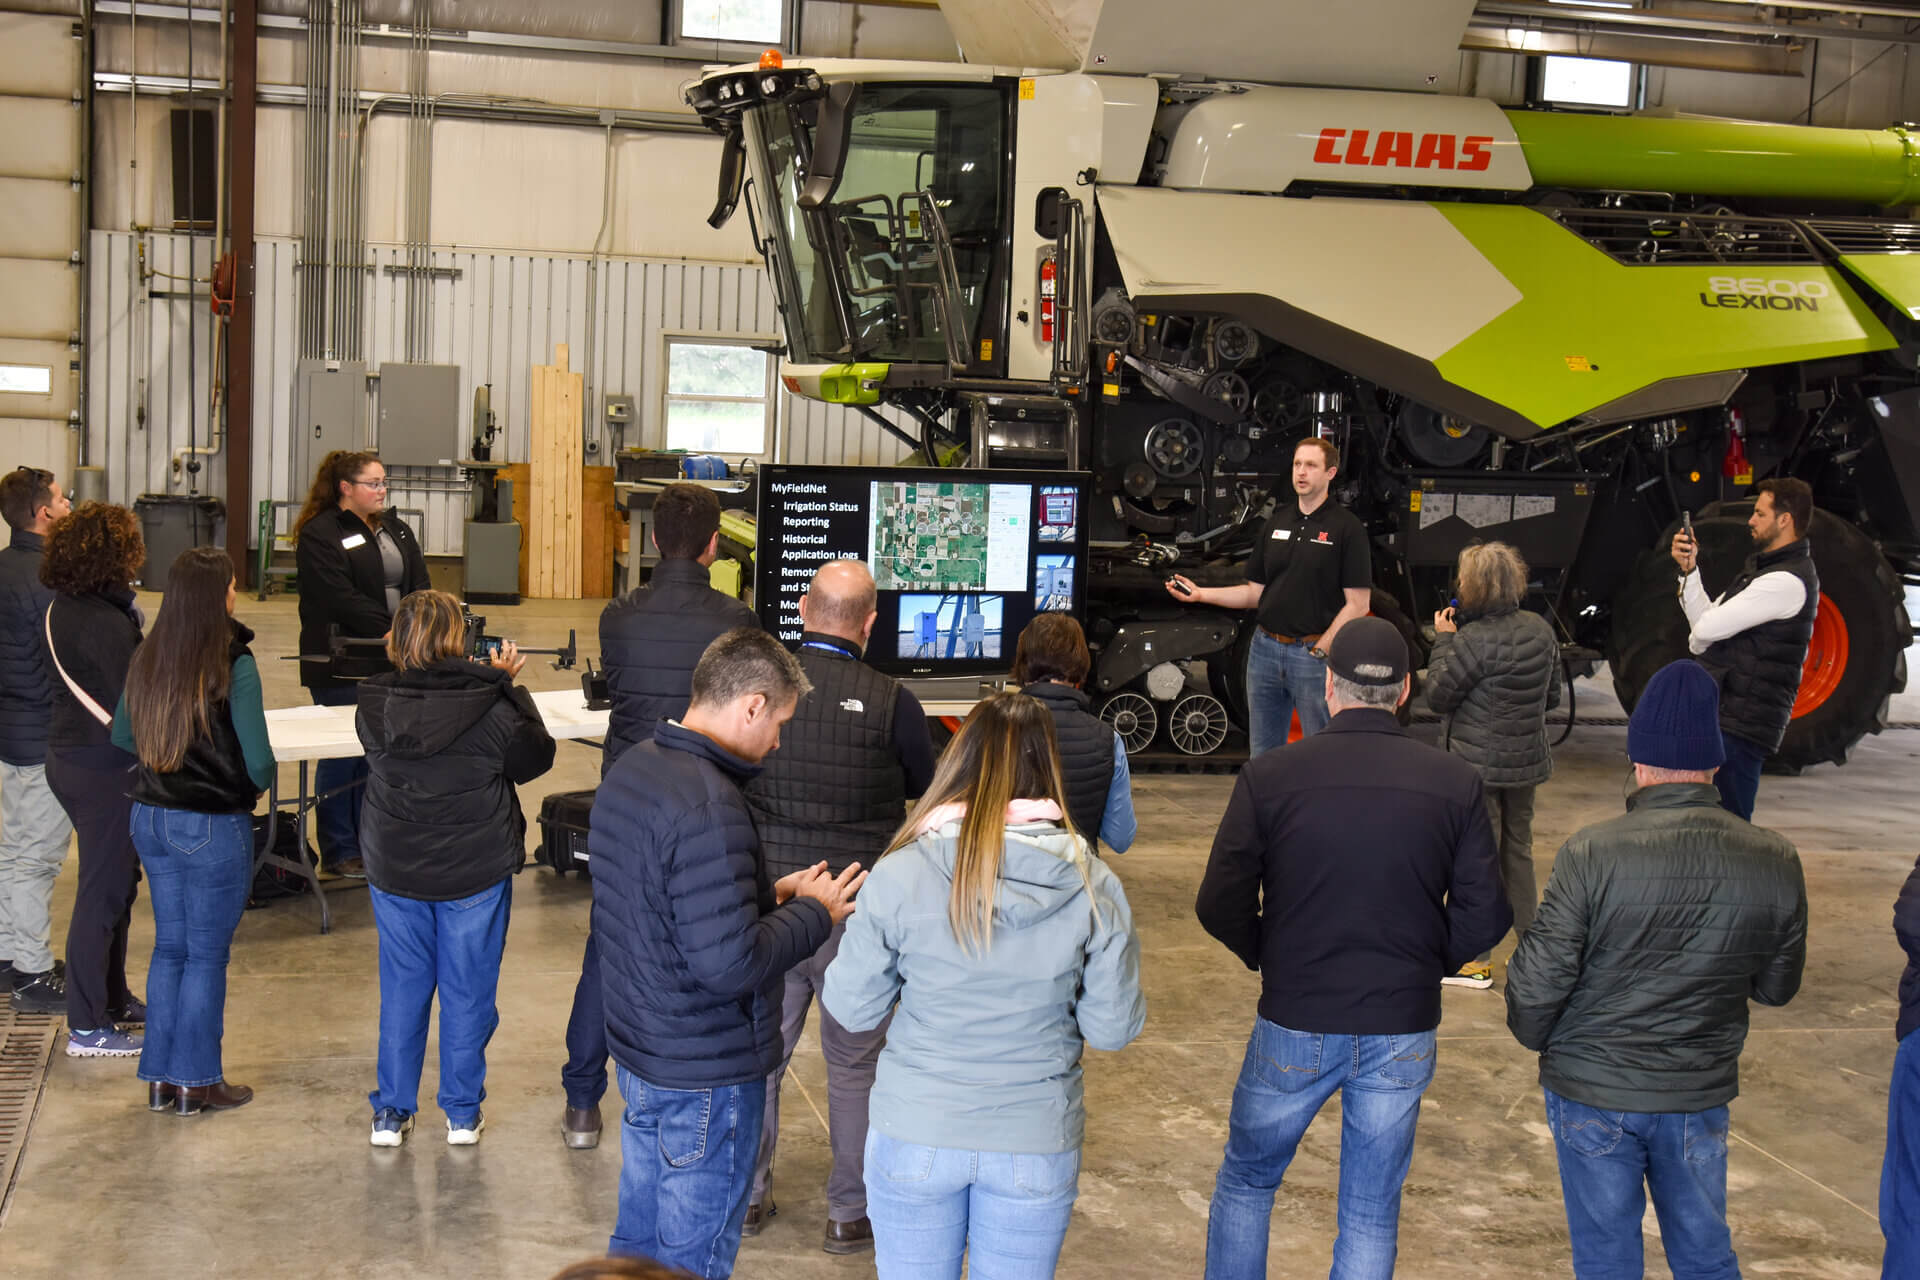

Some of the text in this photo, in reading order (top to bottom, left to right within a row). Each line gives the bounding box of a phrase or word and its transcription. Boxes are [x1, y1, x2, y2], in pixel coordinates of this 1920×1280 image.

[1313, 128, 1494, 171] CLAAS
[1708, 276, 1829, 298] 8600
[1699, 292, 1818, 312] LEXION
[771, 483, 827, 495] MyFieldNet
[783, 501, 859, 513] Irrigation Status
[783, 516, 830, 529] Reporting
[782, 534, 827, 544] Historical
[781, 549, 859, 561] Application Logs
[780, 582, 799, 592] and
[779, 615, 805, 625] Linds
[778, 631, 802, 641] Valle
